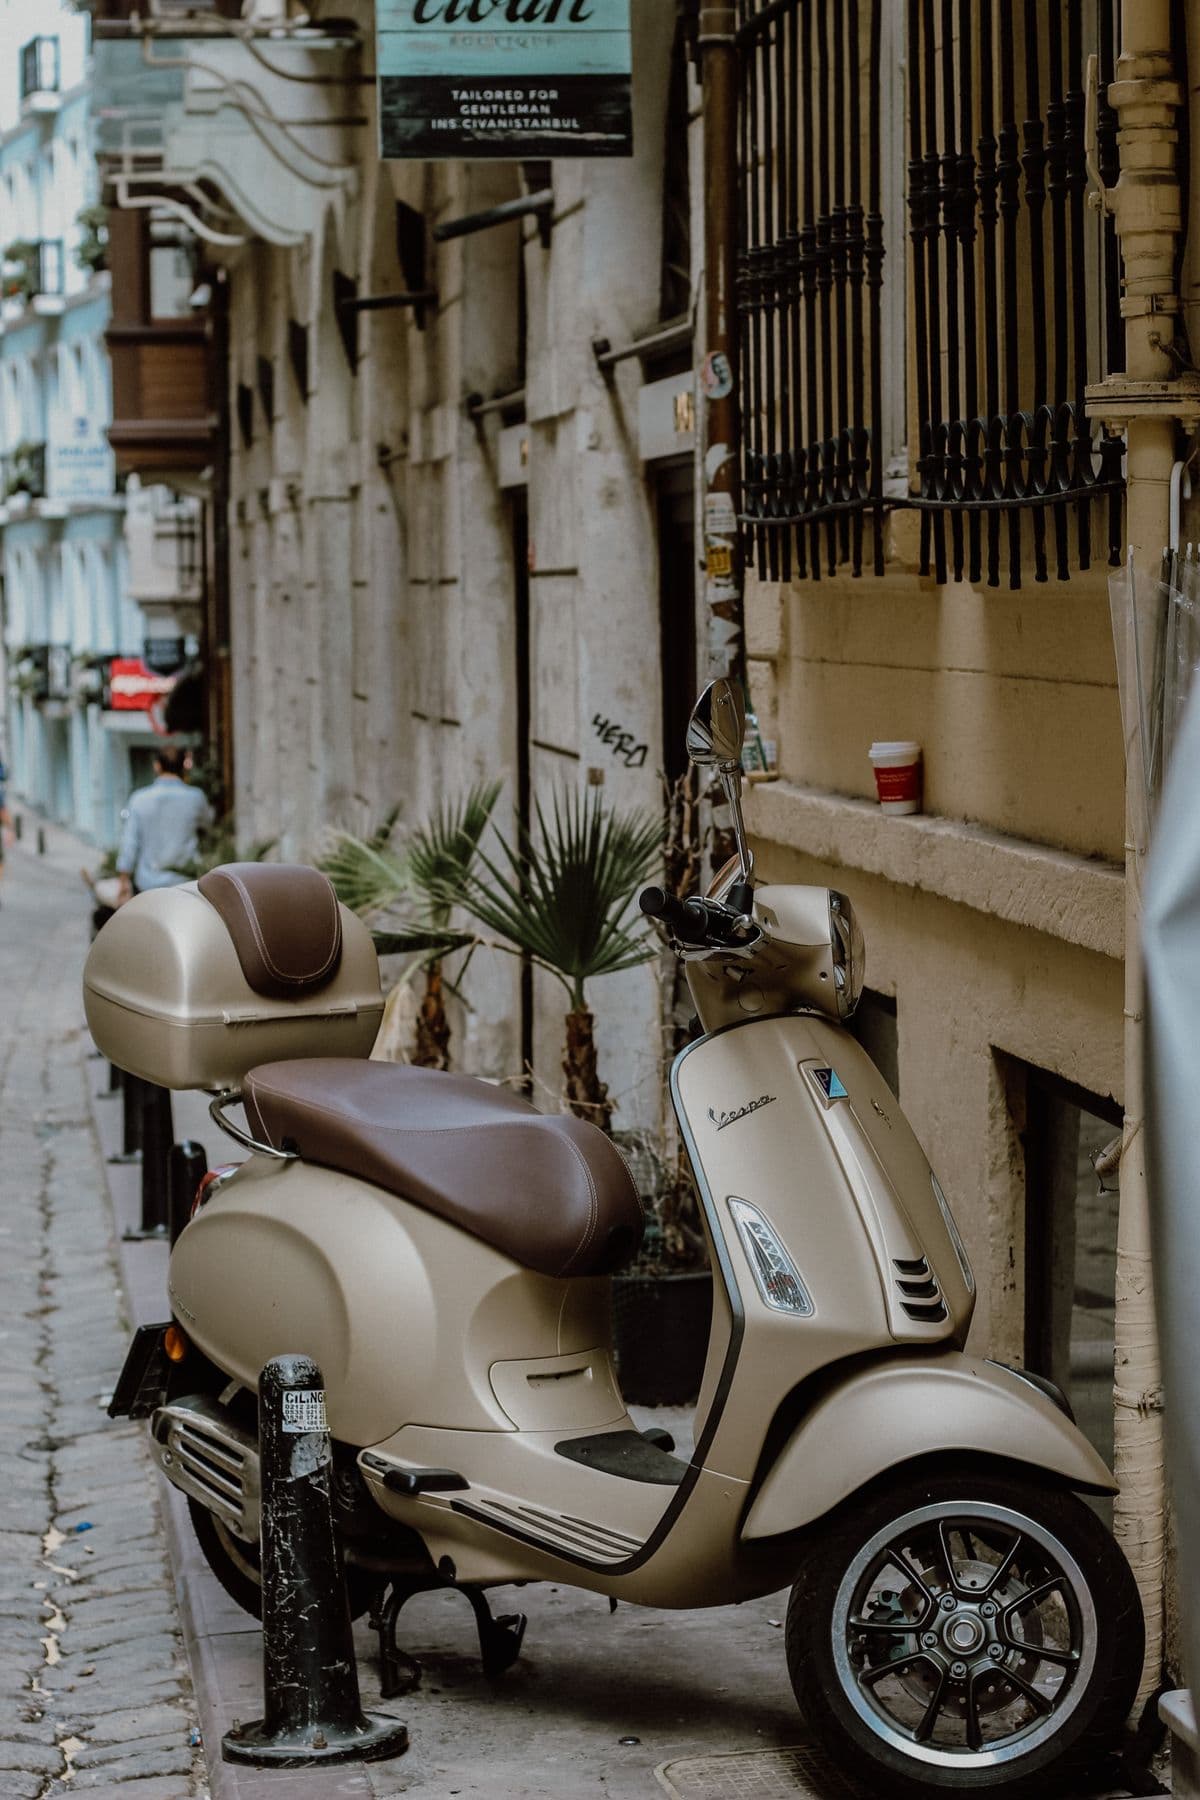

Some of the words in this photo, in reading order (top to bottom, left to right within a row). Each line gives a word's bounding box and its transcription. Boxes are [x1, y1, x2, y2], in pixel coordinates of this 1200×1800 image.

[451, 90, 525, 100] TAILORED
[529, 90, 559, 100] FOR
[460, 104, 551, 115] GENTLEMAN
[708, 1095, 777, 1131] Vespa
